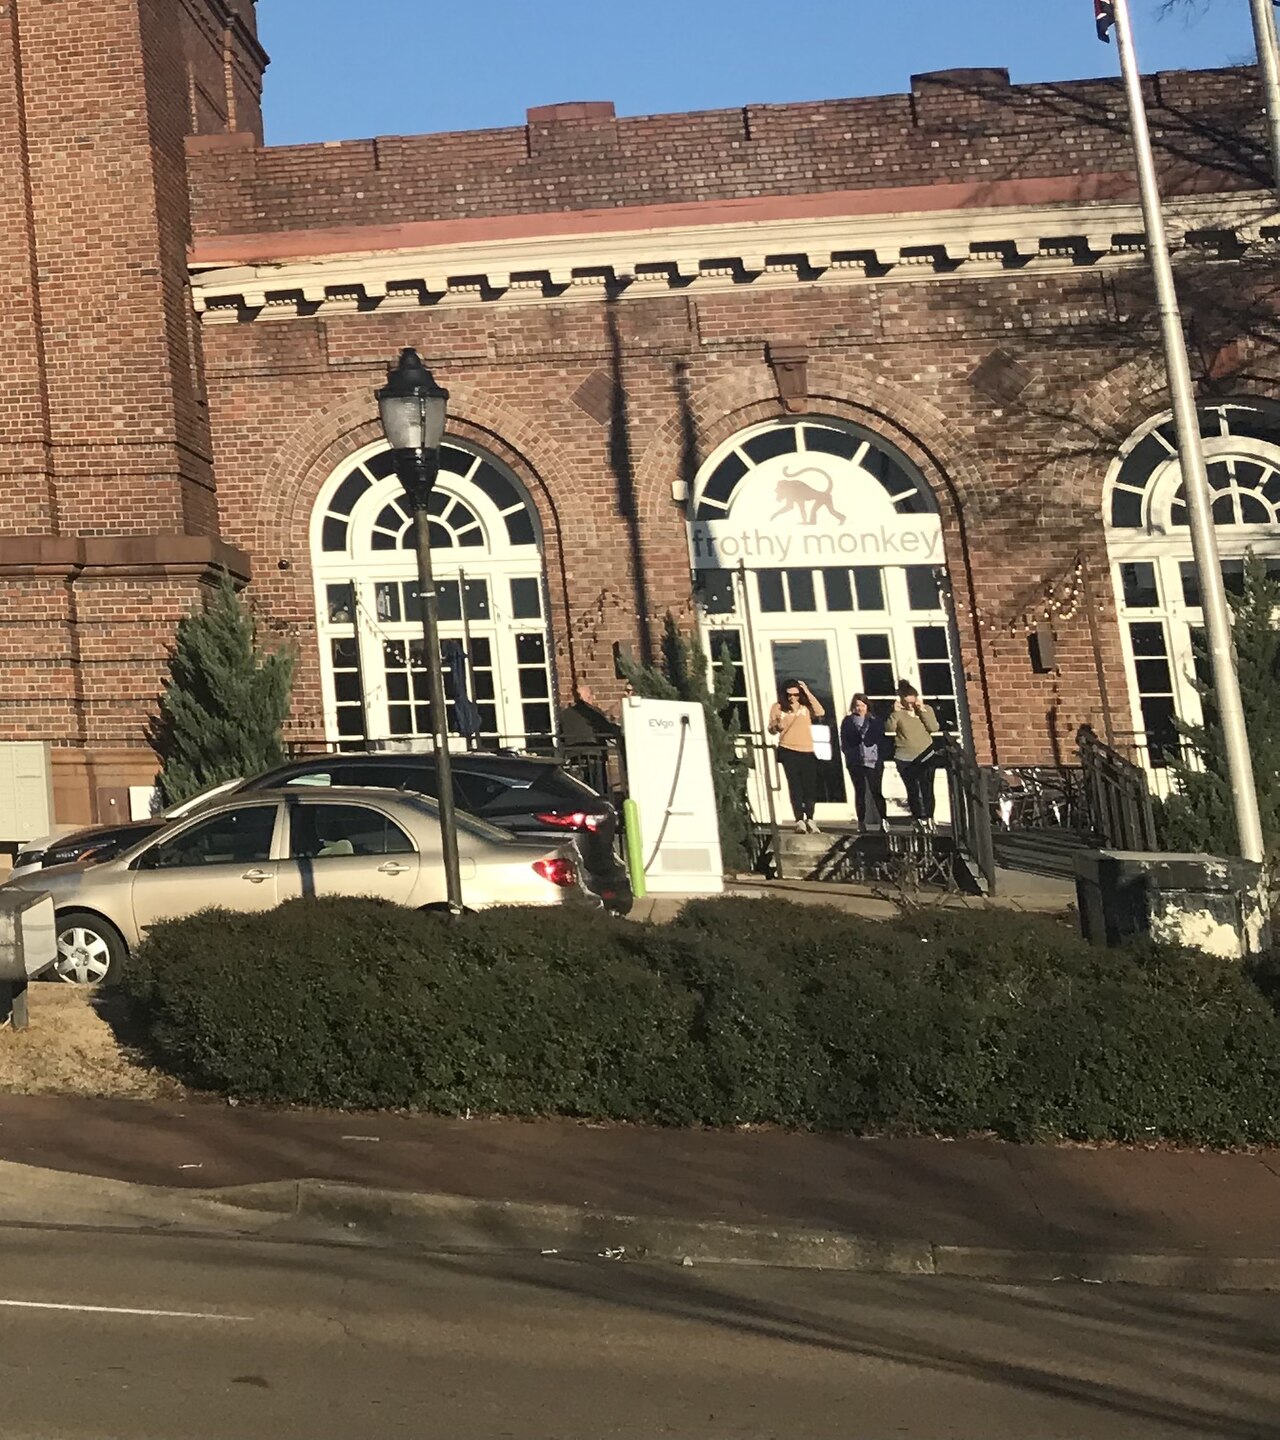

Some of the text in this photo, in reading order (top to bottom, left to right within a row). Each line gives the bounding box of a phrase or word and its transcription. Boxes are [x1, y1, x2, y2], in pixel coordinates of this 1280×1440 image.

[692, 525, 940, 562] frothy monkey
[648, 718, 674, 729] EVgo
